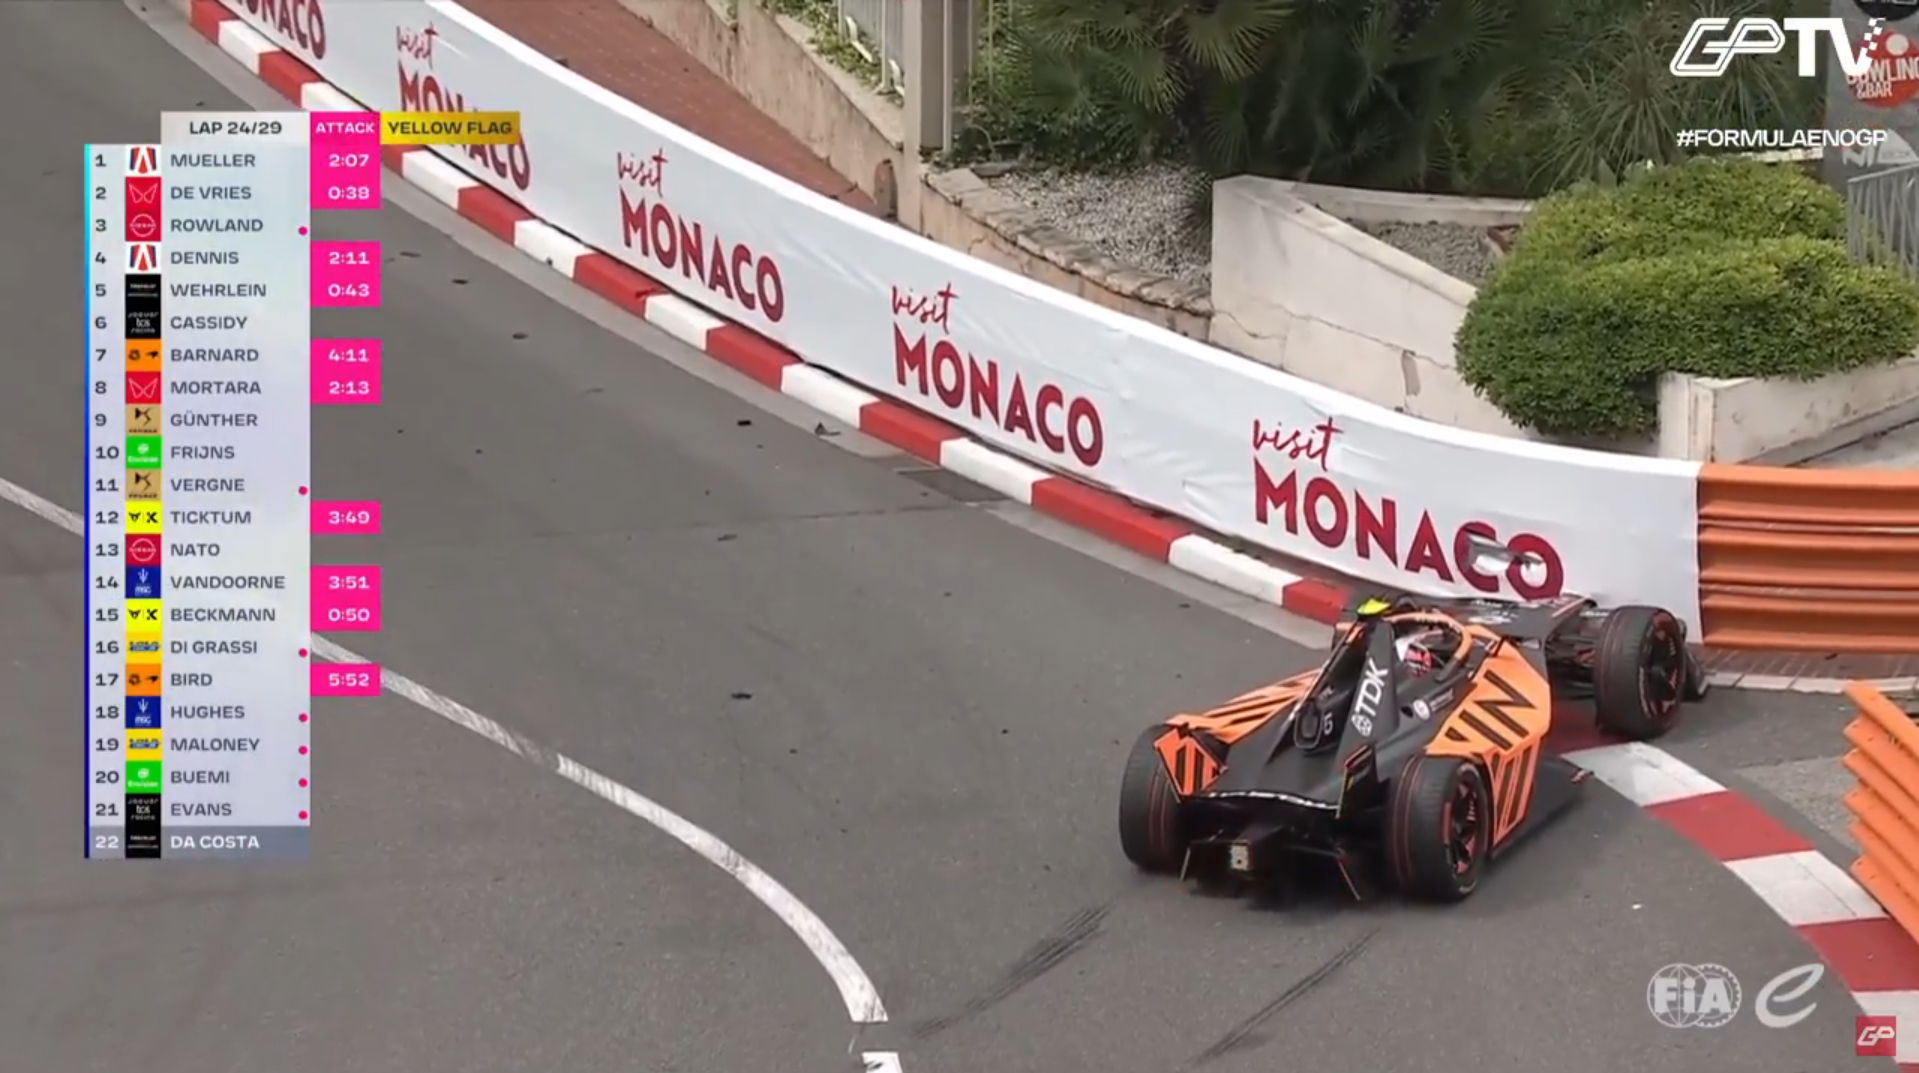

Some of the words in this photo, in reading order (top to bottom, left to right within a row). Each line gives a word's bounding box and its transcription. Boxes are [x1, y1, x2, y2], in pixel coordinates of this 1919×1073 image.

[237, 0, 325, 60] ACO
[617, 147, 668, 198] visit
[619, 185, 784, 322] MONACO
[892, 282, 959, 335] visit
[894, 321, 1103, 467] MONACO
[1253, 417, 1343, 471] visit
[1254, 456, 1564, 600] MONACO
[1354, 659, 1390, 718] TDK
